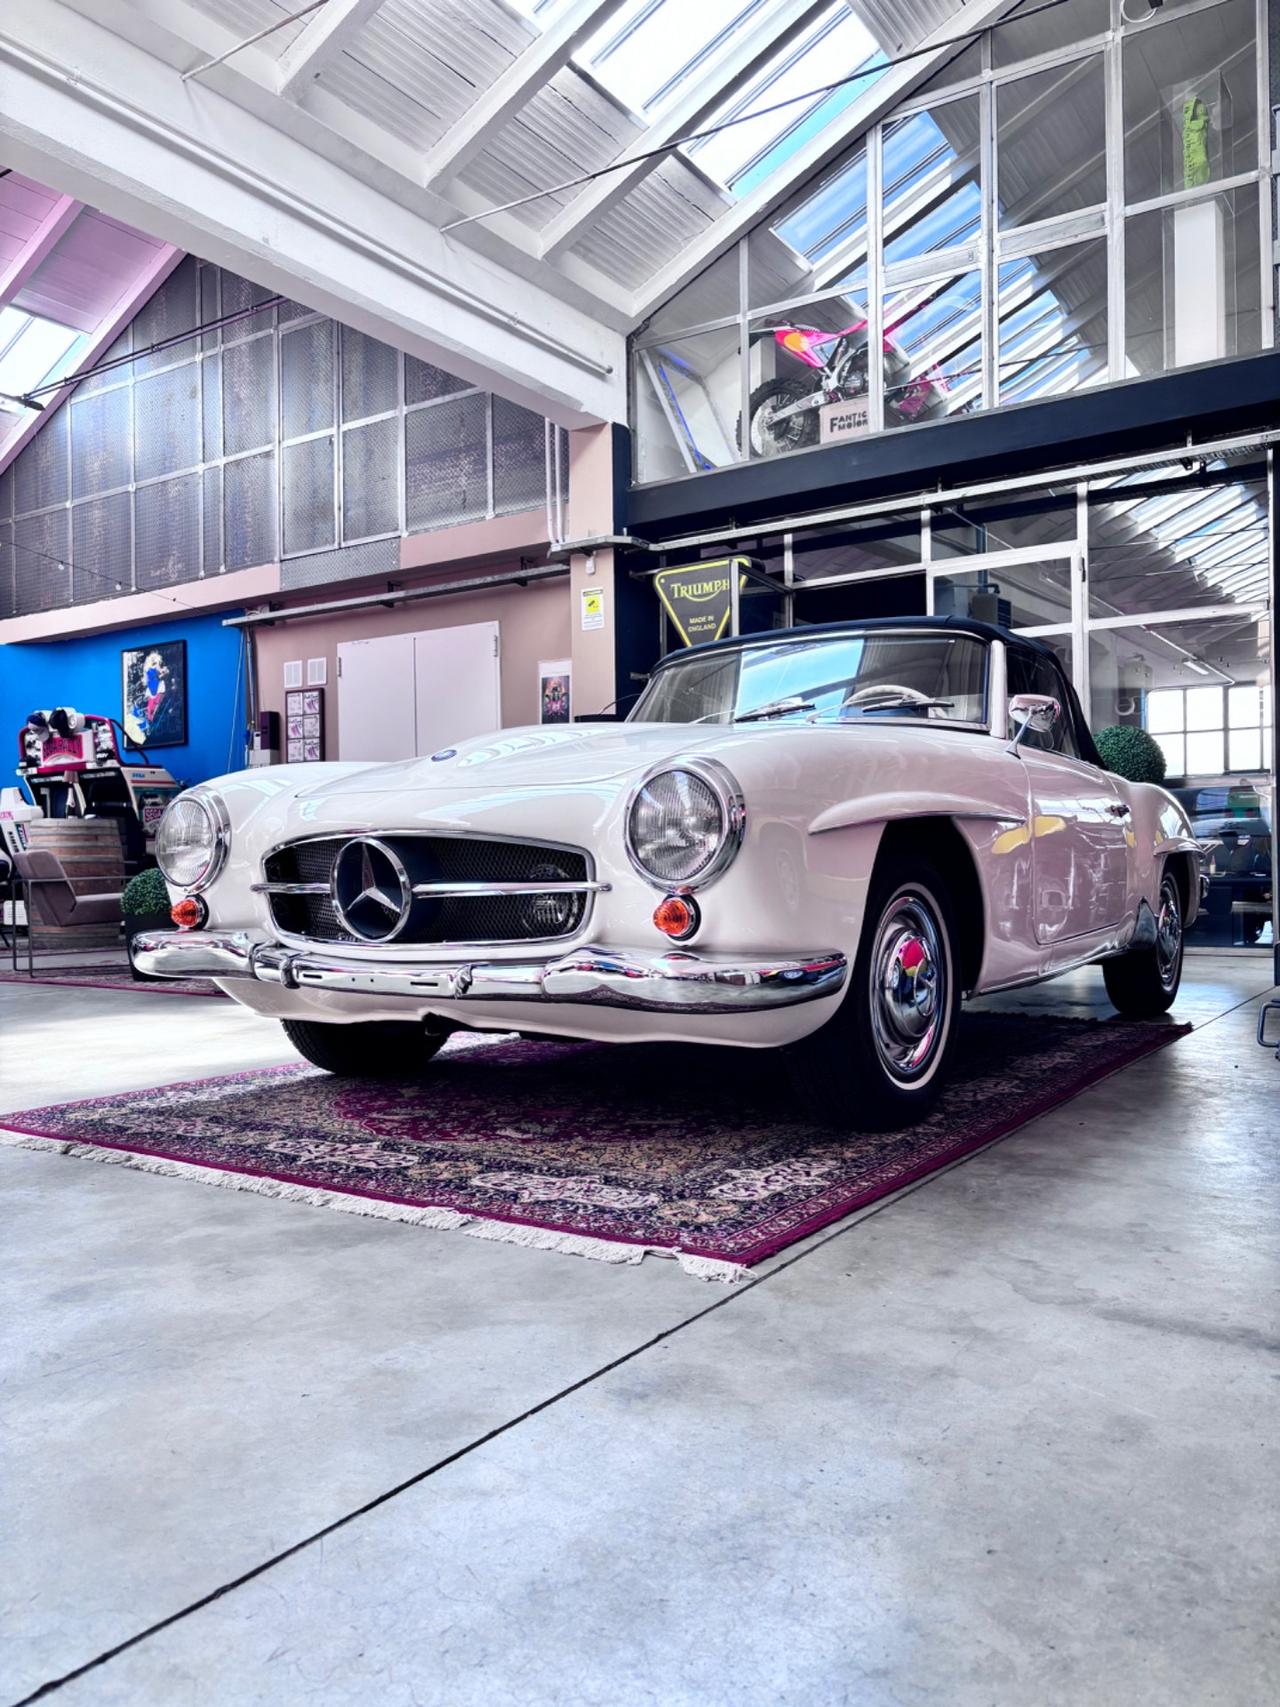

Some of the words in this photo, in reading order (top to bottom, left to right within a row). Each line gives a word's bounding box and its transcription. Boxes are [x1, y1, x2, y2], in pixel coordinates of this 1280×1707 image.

[830, 411, 867, 432] FANTIC
[670, 579, 730, 601] TRIUMPH
[688, 623, 717, 632] ENGLAND
[689, 616, 707, 625] MADE
